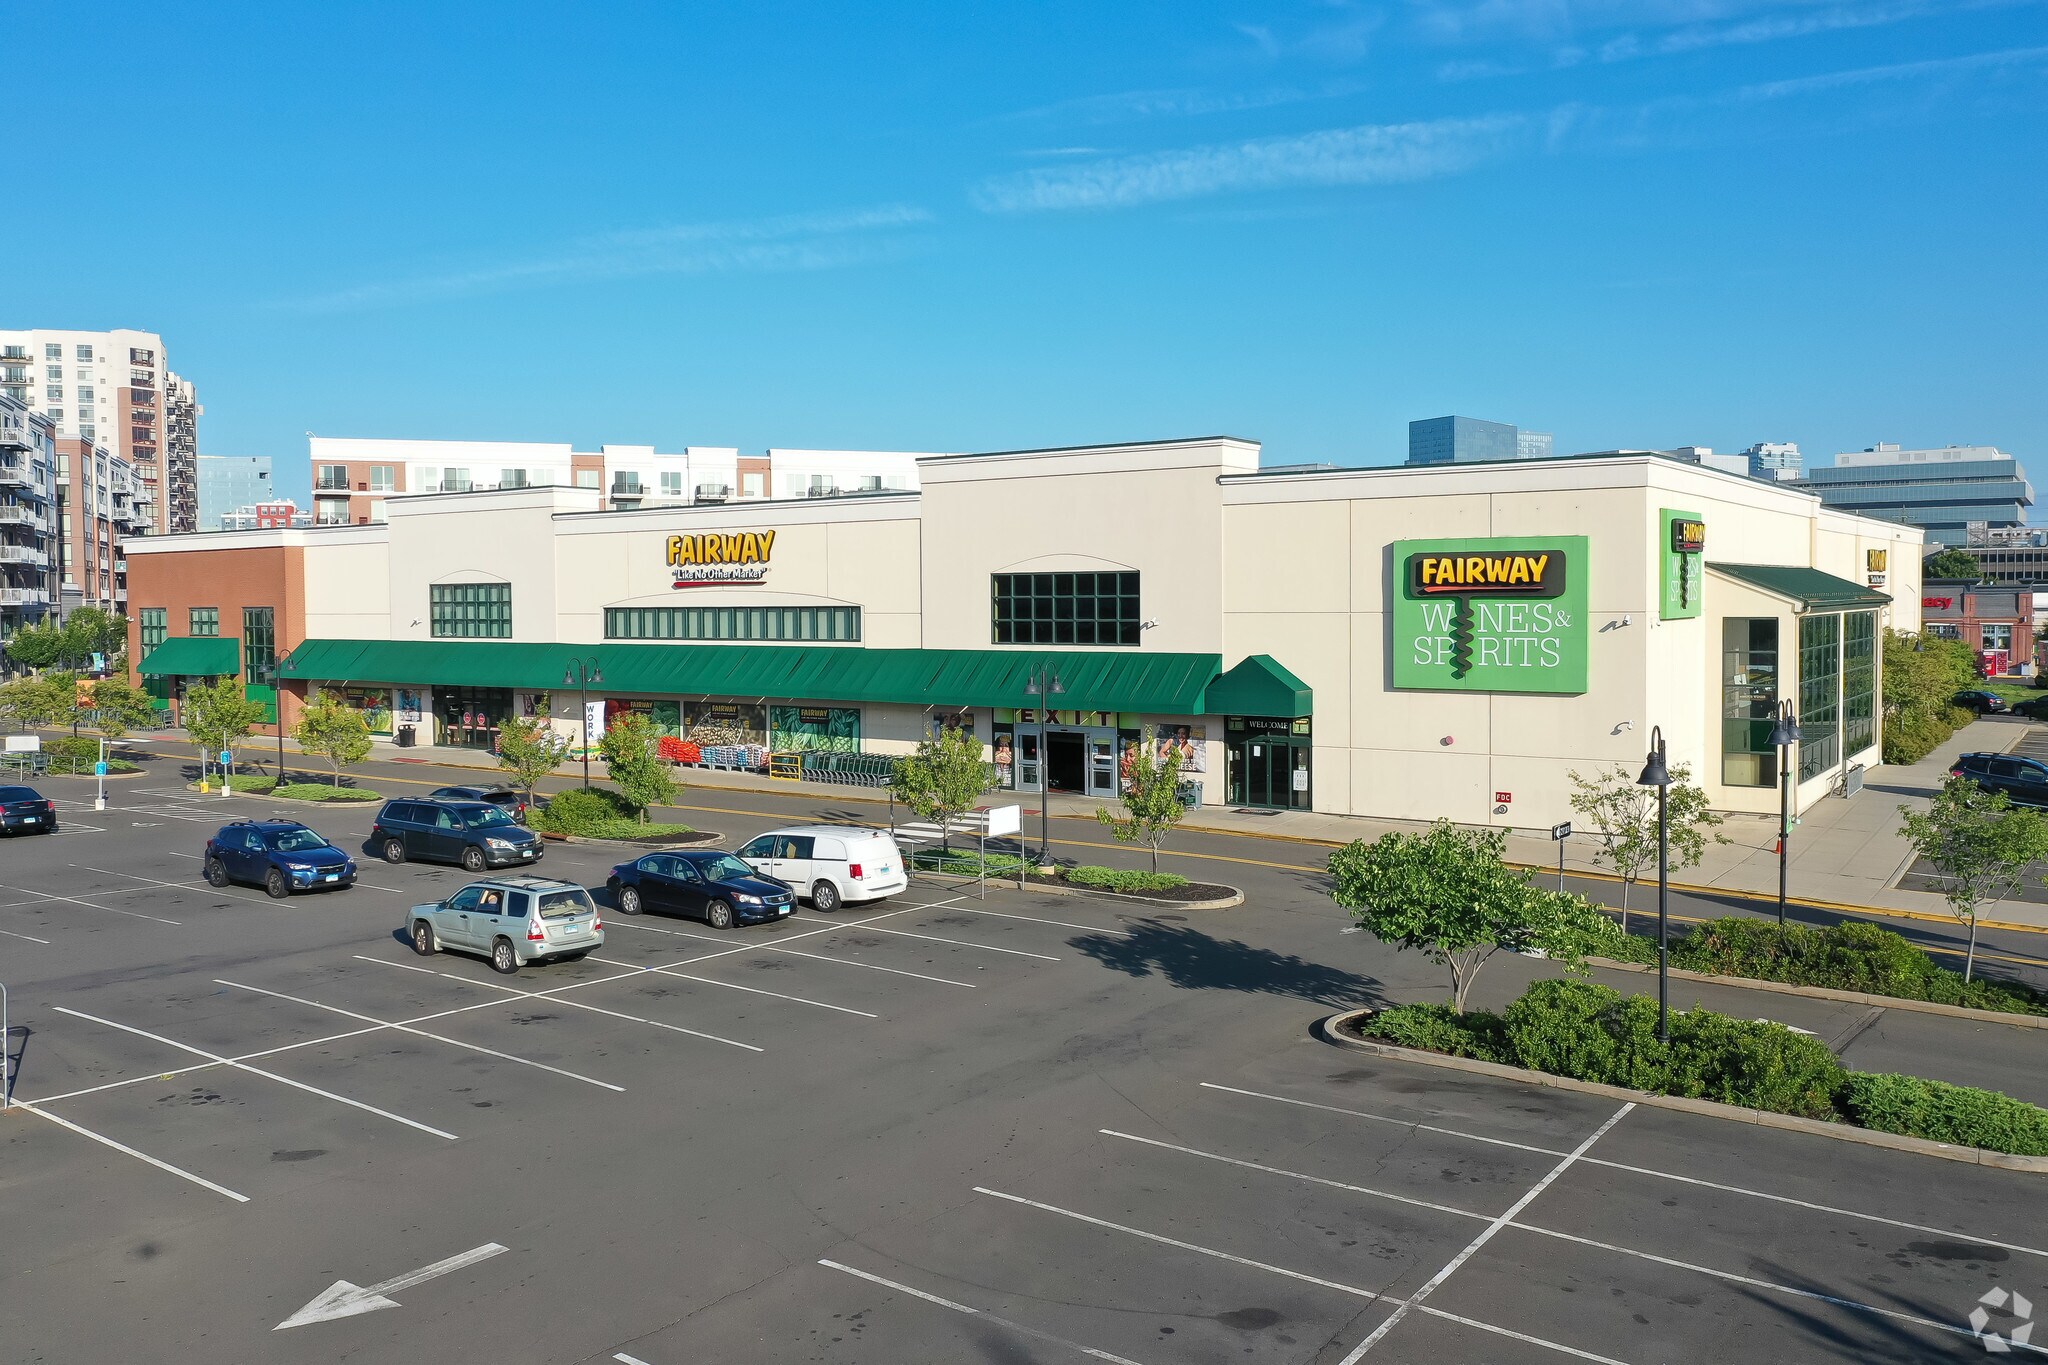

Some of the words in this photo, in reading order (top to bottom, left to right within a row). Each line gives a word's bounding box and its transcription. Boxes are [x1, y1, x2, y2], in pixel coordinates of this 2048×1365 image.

[668, 530, 775, 565] FAIRWAY
[695, 569, 707, 579] No
[708, 568, 731, 579] Other
[1422, 554, 1548, 584] FAIRWAY
[712, 704, 737, 712] FAIRWAY
[801, 708, 828, 716] FAIRWAY
[586, 705, 594, 738] WORK
[1021, 709, 1111, 726] EXIT
[1249, 720, 1288, 729] WELCOME
